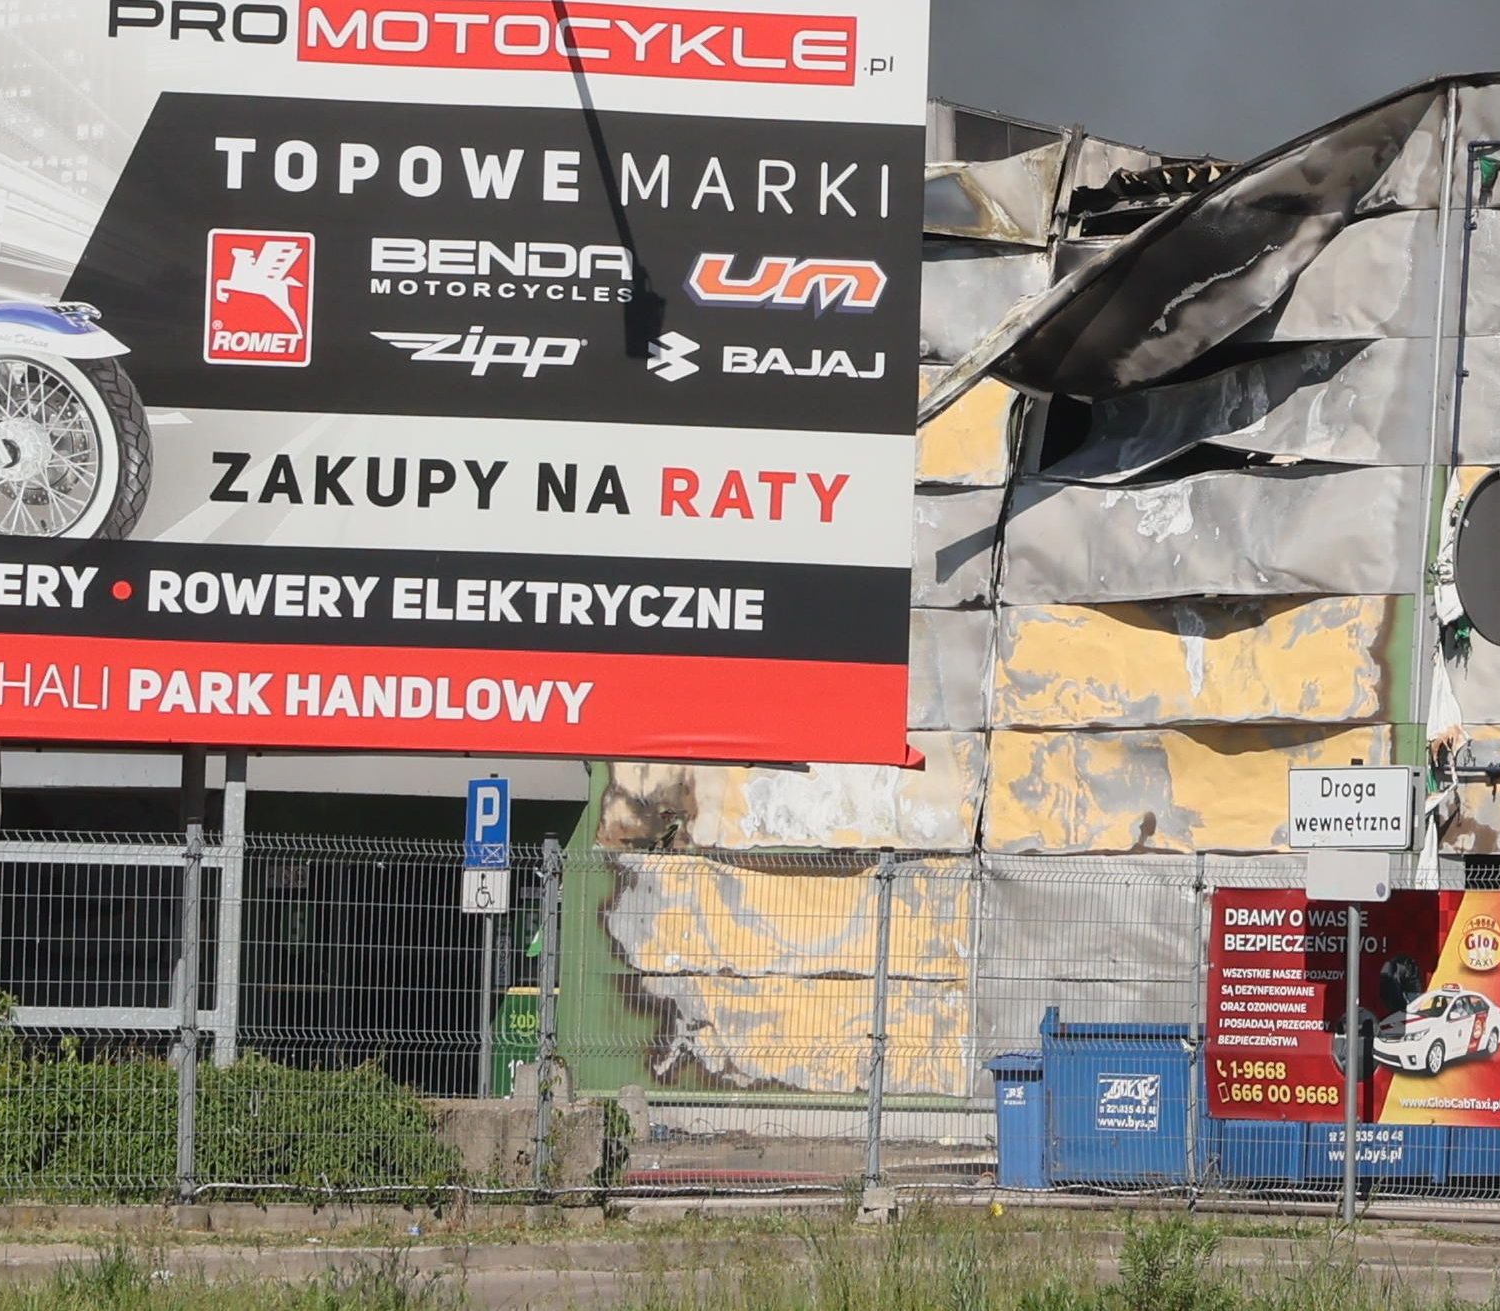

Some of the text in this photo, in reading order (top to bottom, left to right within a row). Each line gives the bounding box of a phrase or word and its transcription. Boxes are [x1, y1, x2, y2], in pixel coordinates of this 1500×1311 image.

[215, 137, 891, 218] TOPOWE MARKI
[371, 239, 634, 281] BENDA
[371, 280, 634, 304] MOTORCYCLES
[212, 329, 301, 355] ROMET
[723, 346, 886, 380] BAJAJ
[210, 452, 851, 523] ZAKUPY NA RATY
[147, 570, 381, 620] ROWERY
[392, 578, 765, 632] ELEKTRYCZNE
[128, 670, 271, 717] PARK
[285, 675, 595, 726] HANDLOWY
[1321, 776, 1376, 804] Droga
[475, 786, 500, 842] P
[1294, 812, 1401, 837] wewnętrzna
[1225, 908, 1368, 927] DBAMY O WASE
[1465, 934, 1499, 951] Glob
[1222, 968, 1344, 980] WSZYSTKIE NASZE POJAZDY
[1469, 958, 1493, 967] TAXI
[1221, 985, 1315, 997] SĄ DEZYNFEKOWANE
[1220, 1002, 1307, 1014] ORAZ OZONOWANE
[1224, 1019, 1275, 1031] POSIADAJĄ
[1276, 1020, 1330, 1031] PRZEGRODY
[1218, 1033, 1298, 1047] BEZPIECZEŃSTWA
[1230, 1061, 1286, 1079] 1-9668
[1231, 1084, 1339, 1104] 666 00 9668
